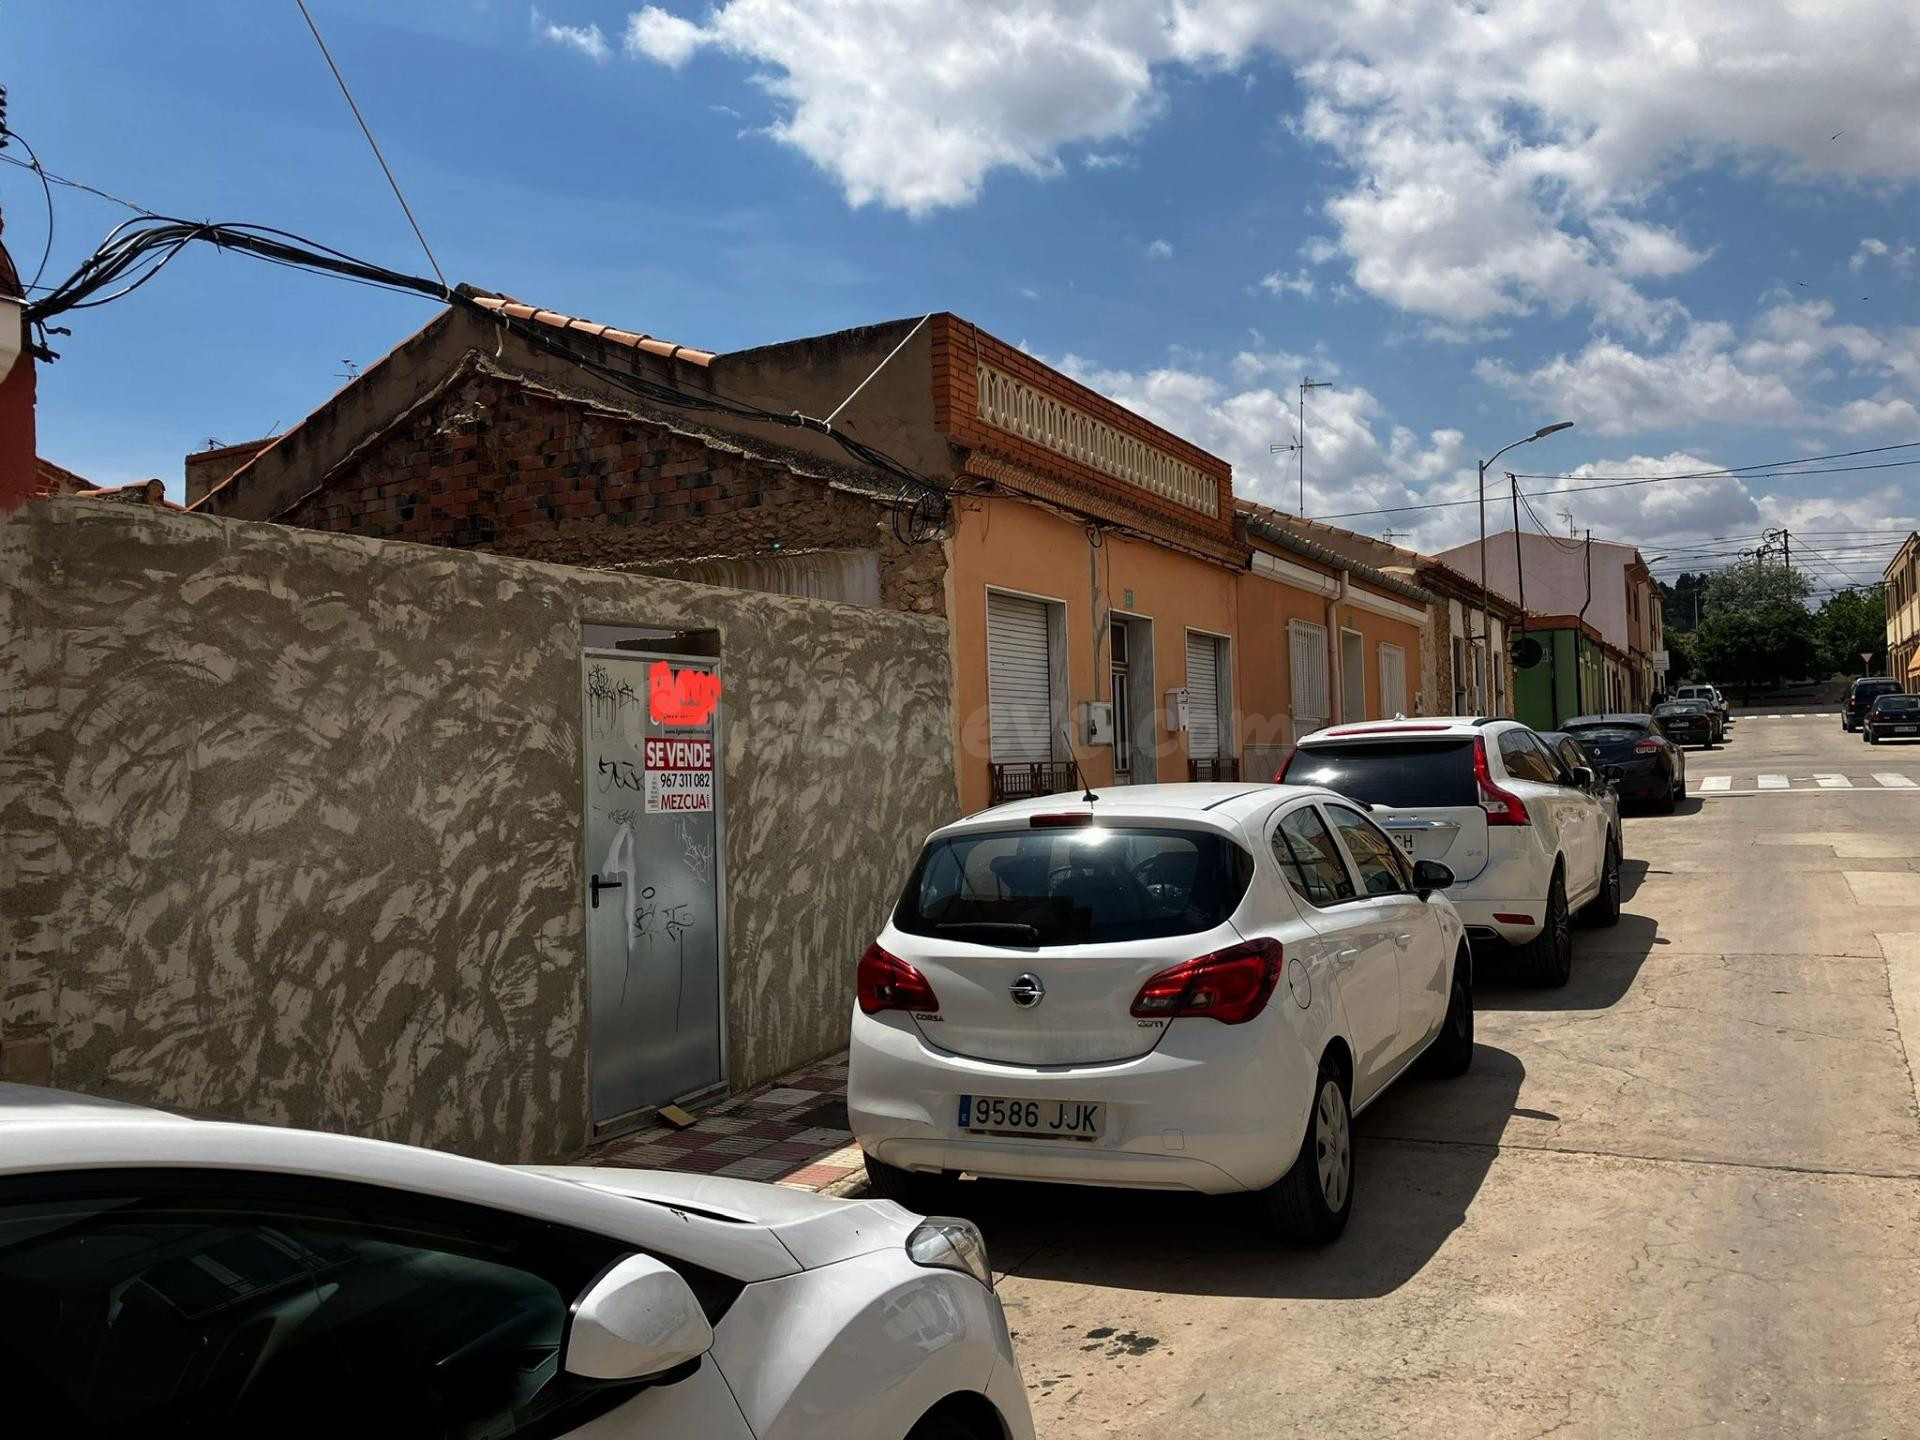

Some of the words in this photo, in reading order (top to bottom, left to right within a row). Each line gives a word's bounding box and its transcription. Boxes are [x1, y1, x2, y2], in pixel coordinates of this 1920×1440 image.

[647, 741, 665, 767] SE
[666, 742, 711, 767] VENDE
[660, 773, 677, 788] 967
[679, 773, 692, 787] 311
[694, 773, 710, 787] 082
[661, 794, 706, 810] MEZCUA
[976, 1099, 1039, 1127] 9586
[1049, 1103, 1098, 1132] JJK
